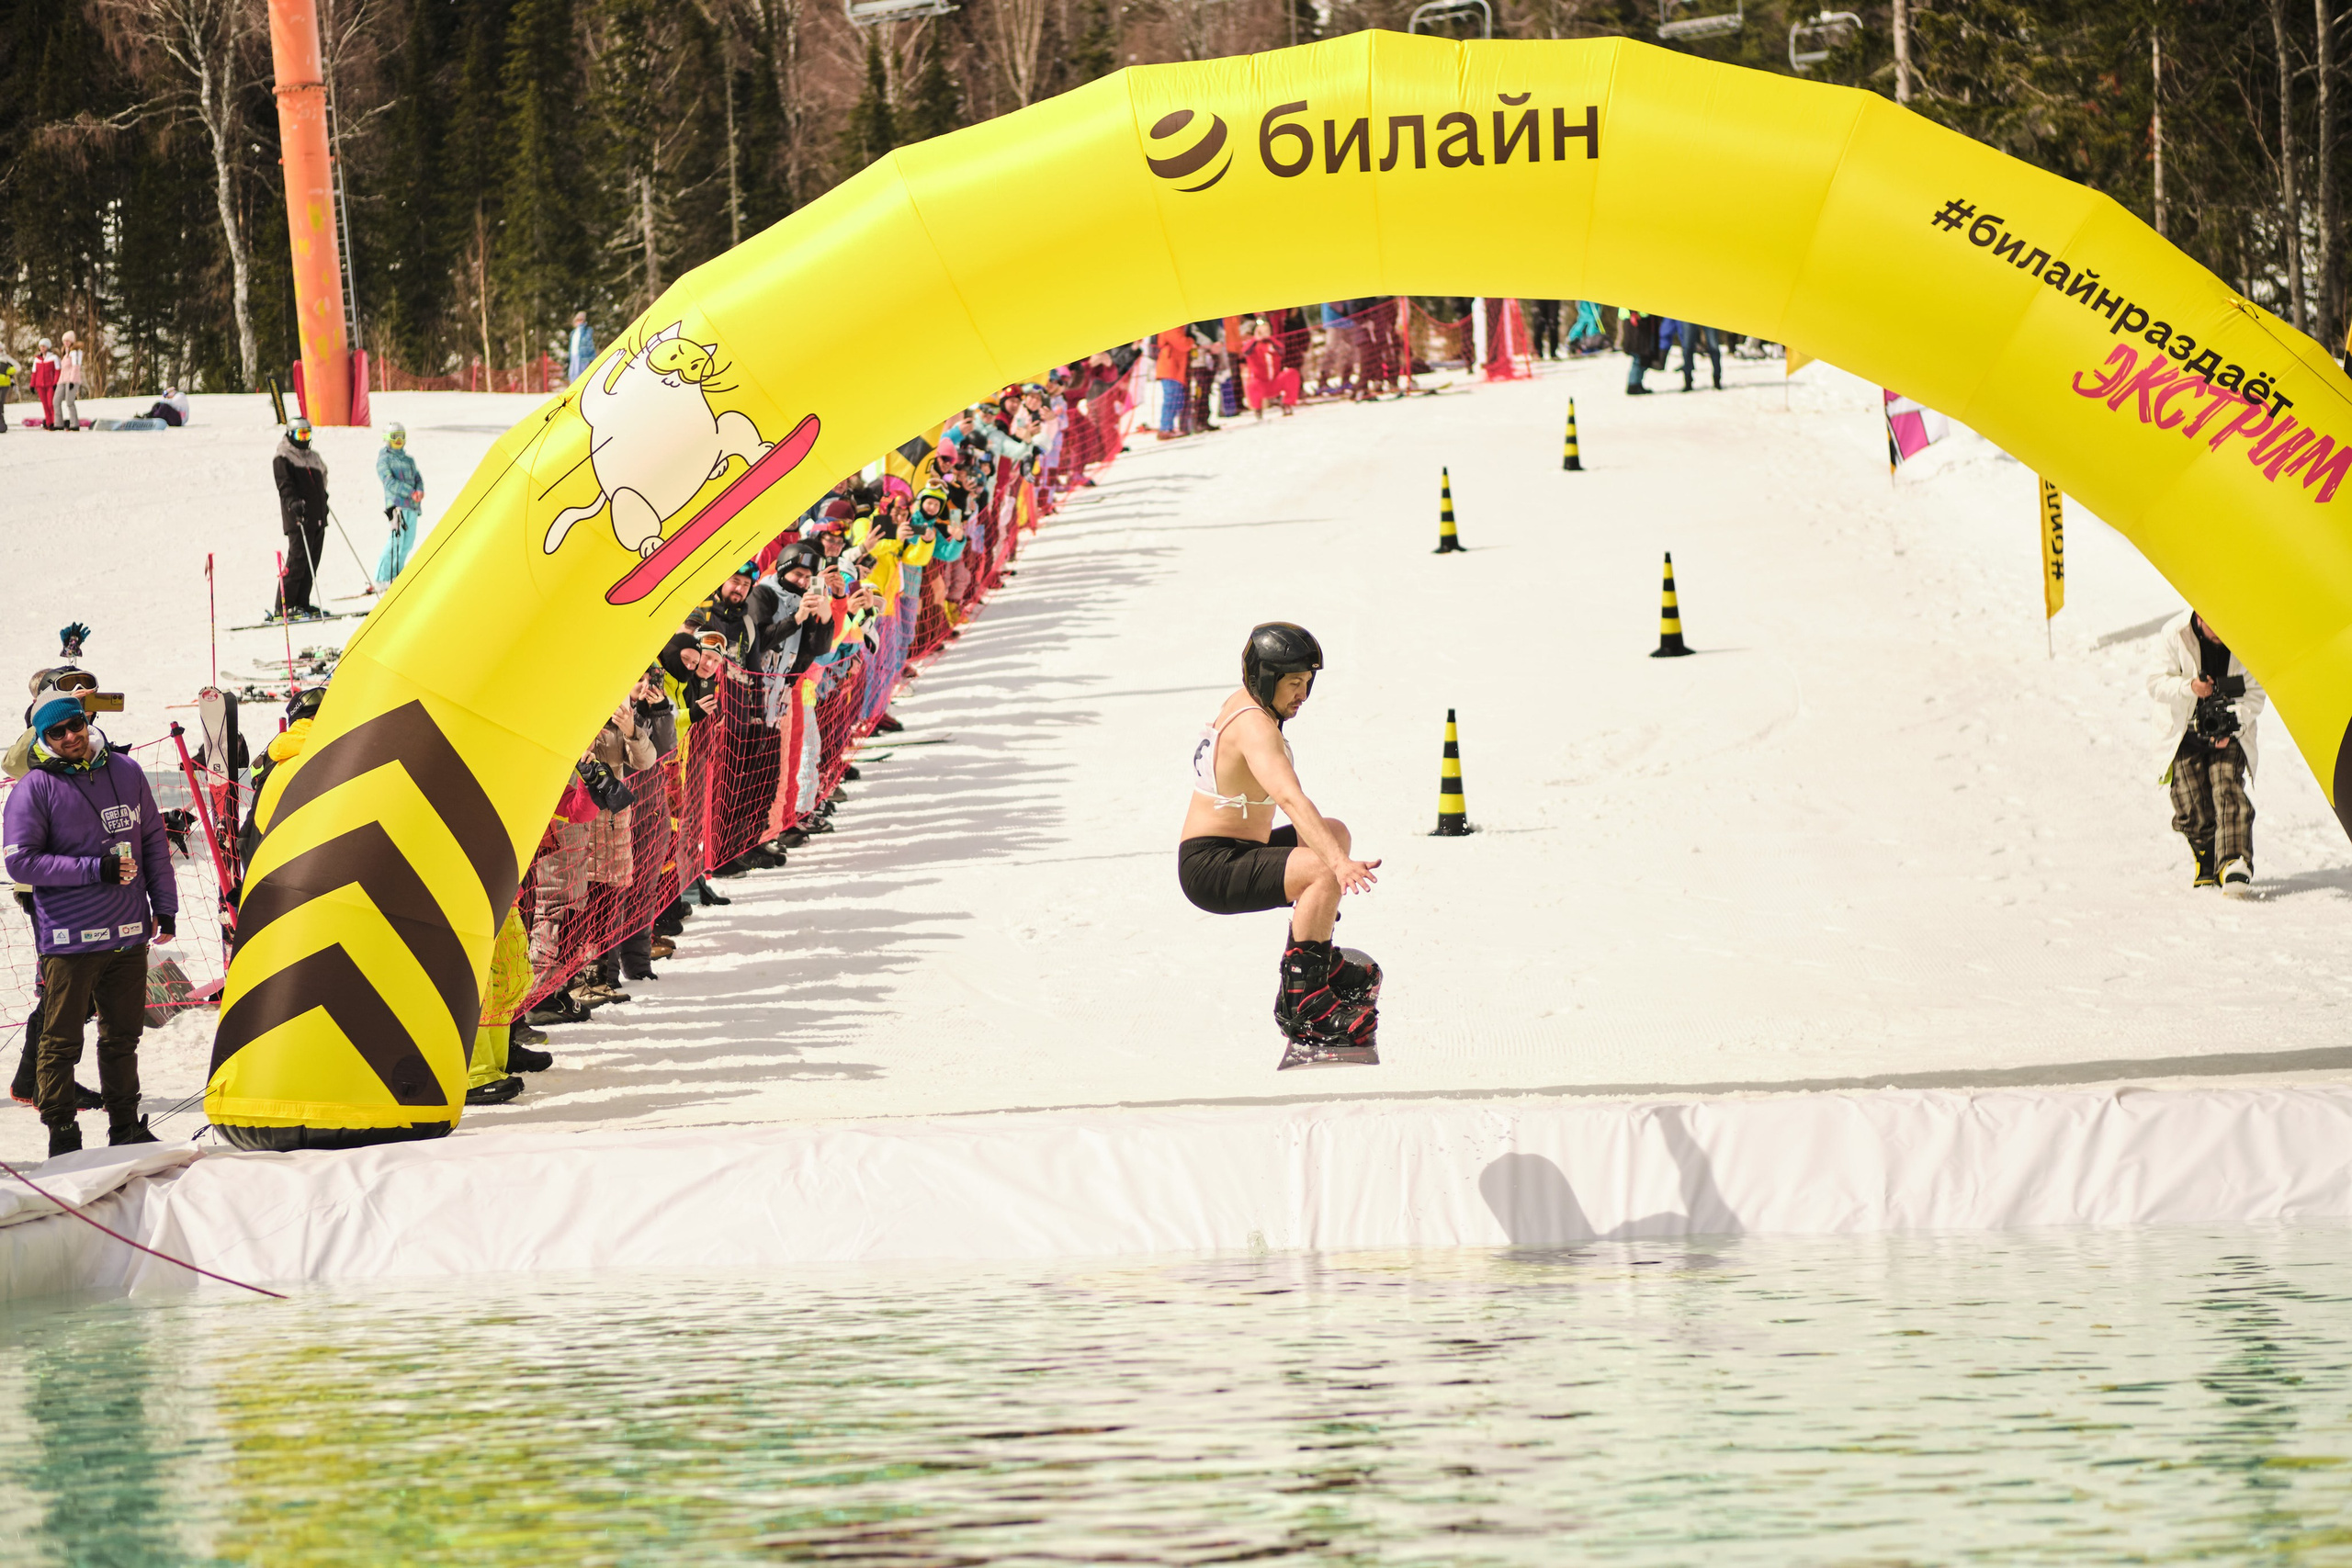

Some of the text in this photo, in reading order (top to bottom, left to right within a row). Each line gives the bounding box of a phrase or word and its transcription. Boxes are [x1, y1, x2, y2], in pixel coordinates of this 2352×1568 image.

[1259, 92, 1599, 178] билайн
[1930, 198, 2294, 419] #билайнраздаёт
[2072, 343, 2352, 503] ЭКСТРИМ
